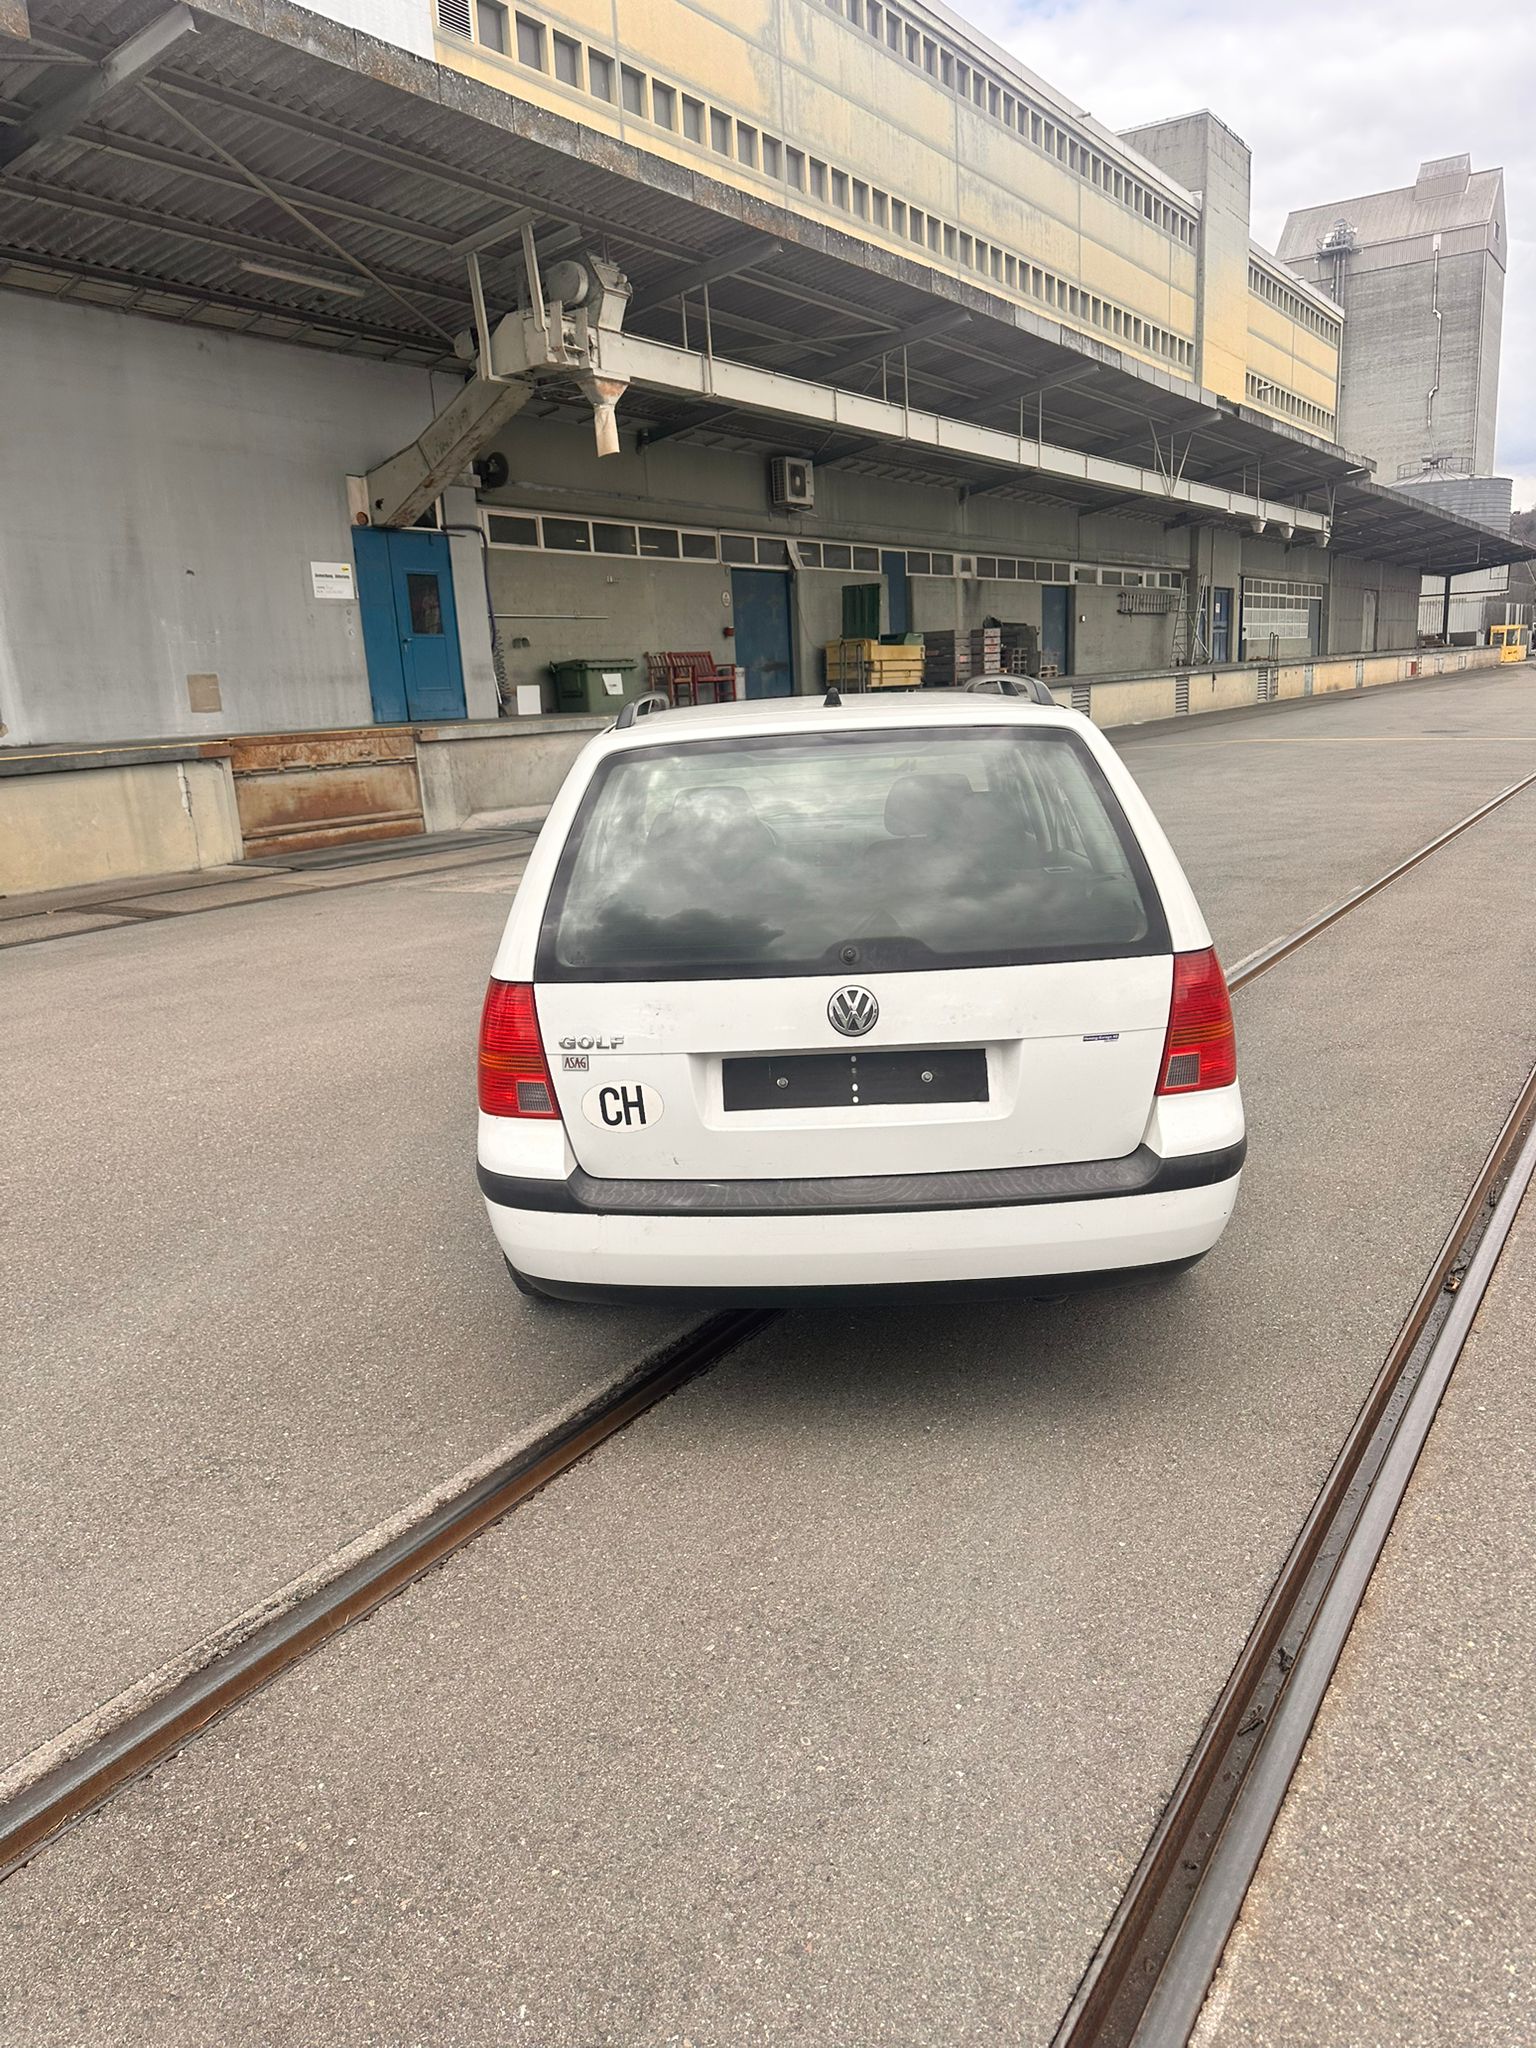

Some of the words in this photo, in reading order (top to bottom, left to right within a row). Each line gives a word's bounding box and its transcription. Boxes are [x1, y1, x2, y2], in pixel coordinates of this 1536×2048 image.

[829, 986, 877, 1035] VW
[559, 1035, 625, 1050] GOLF
[598, 1085, 646, 1126] CH
